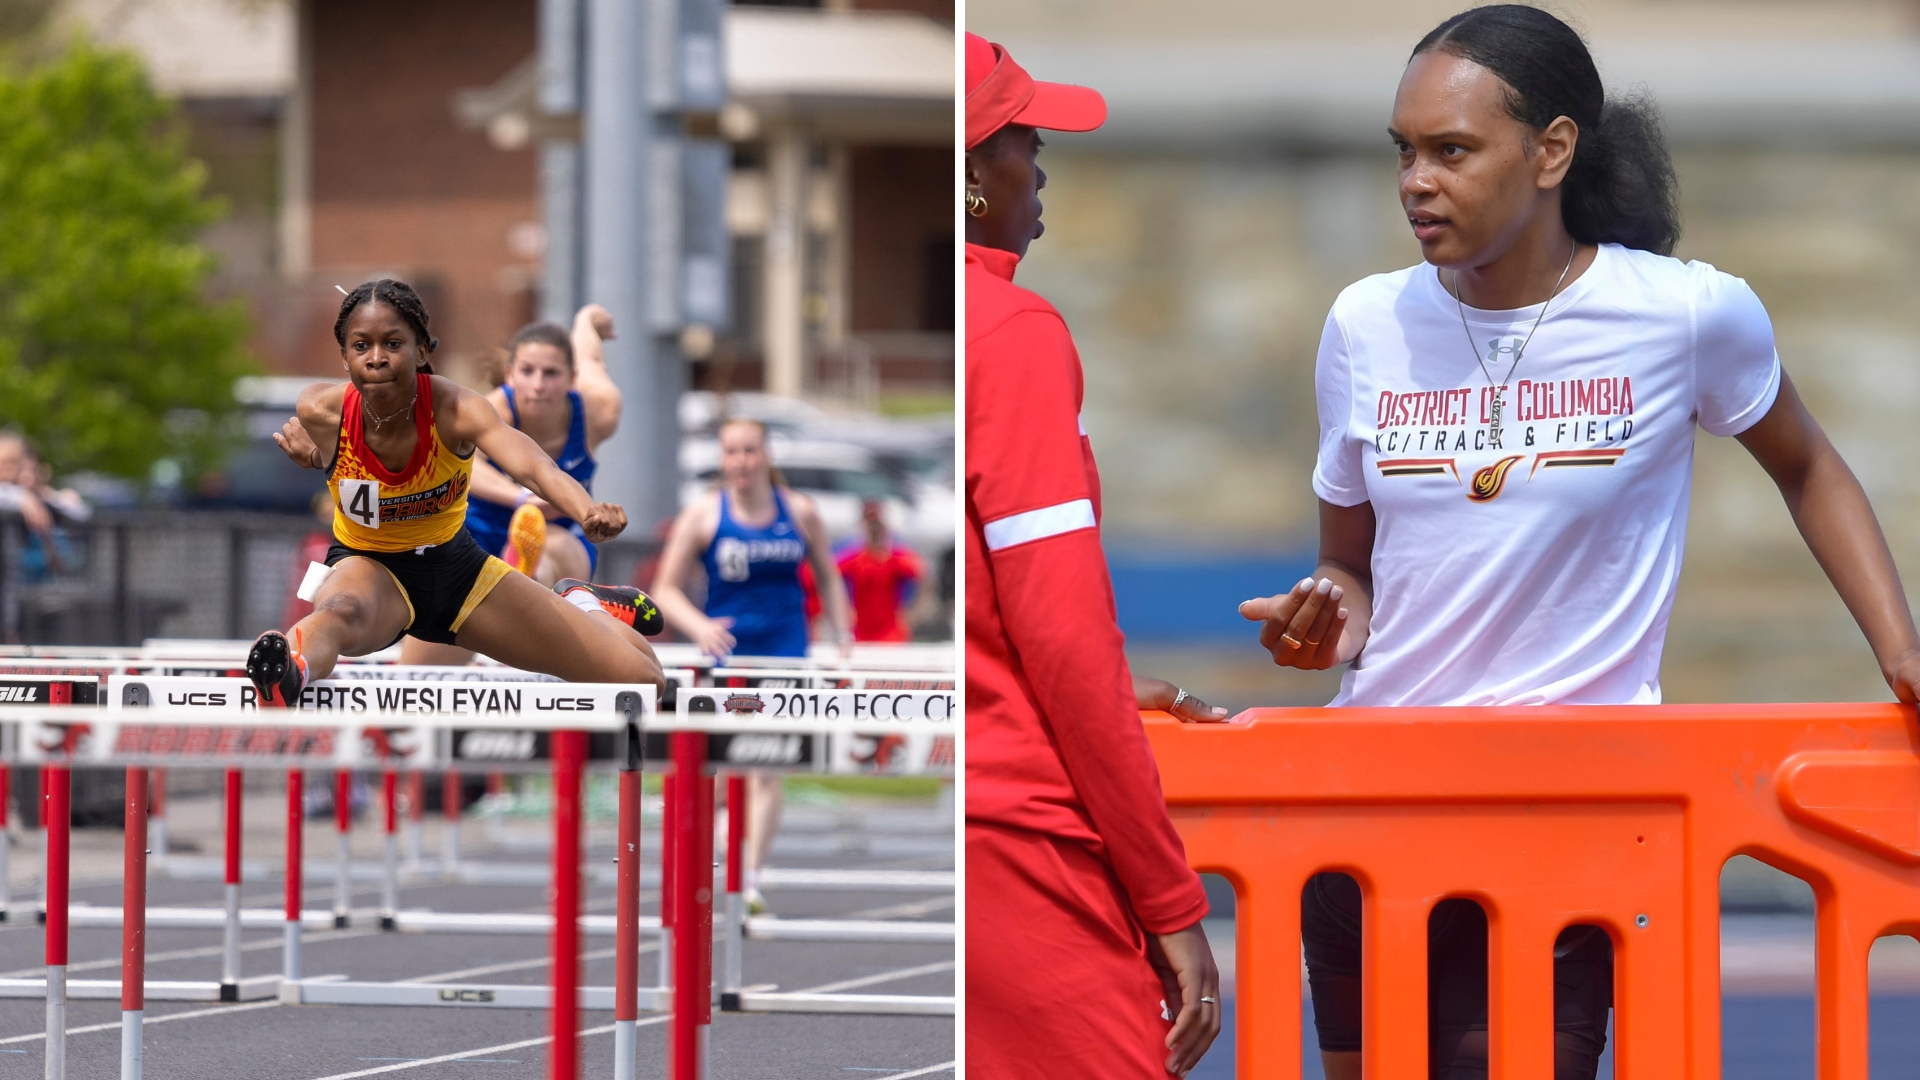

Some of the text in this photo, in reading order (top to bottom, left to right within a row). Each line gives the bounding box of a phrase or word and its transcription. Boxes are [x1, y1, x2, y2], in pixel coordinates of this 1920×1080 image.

[1377, 388, 1472, 430] DISTRICT
[1517, 376, 1634, 422] COLUMBIA
[1524, 426, 1535, 447] &
[1556, 419, 1635, 443] FIELD
[350, 484, 374, 526] 4
[424, 491, 434, 499] OF
[435, 484, 449, 495] THE
[168, 692, 227, 706] UCS
[241, 685, 522, 718] RERTS WESLEYAN
[536, 697, 595, 711] UCS
[772, 692, 840, 722] 2016
[853, 693, 913, 723] ECC
[440, 988, 496, 1003] UCS
